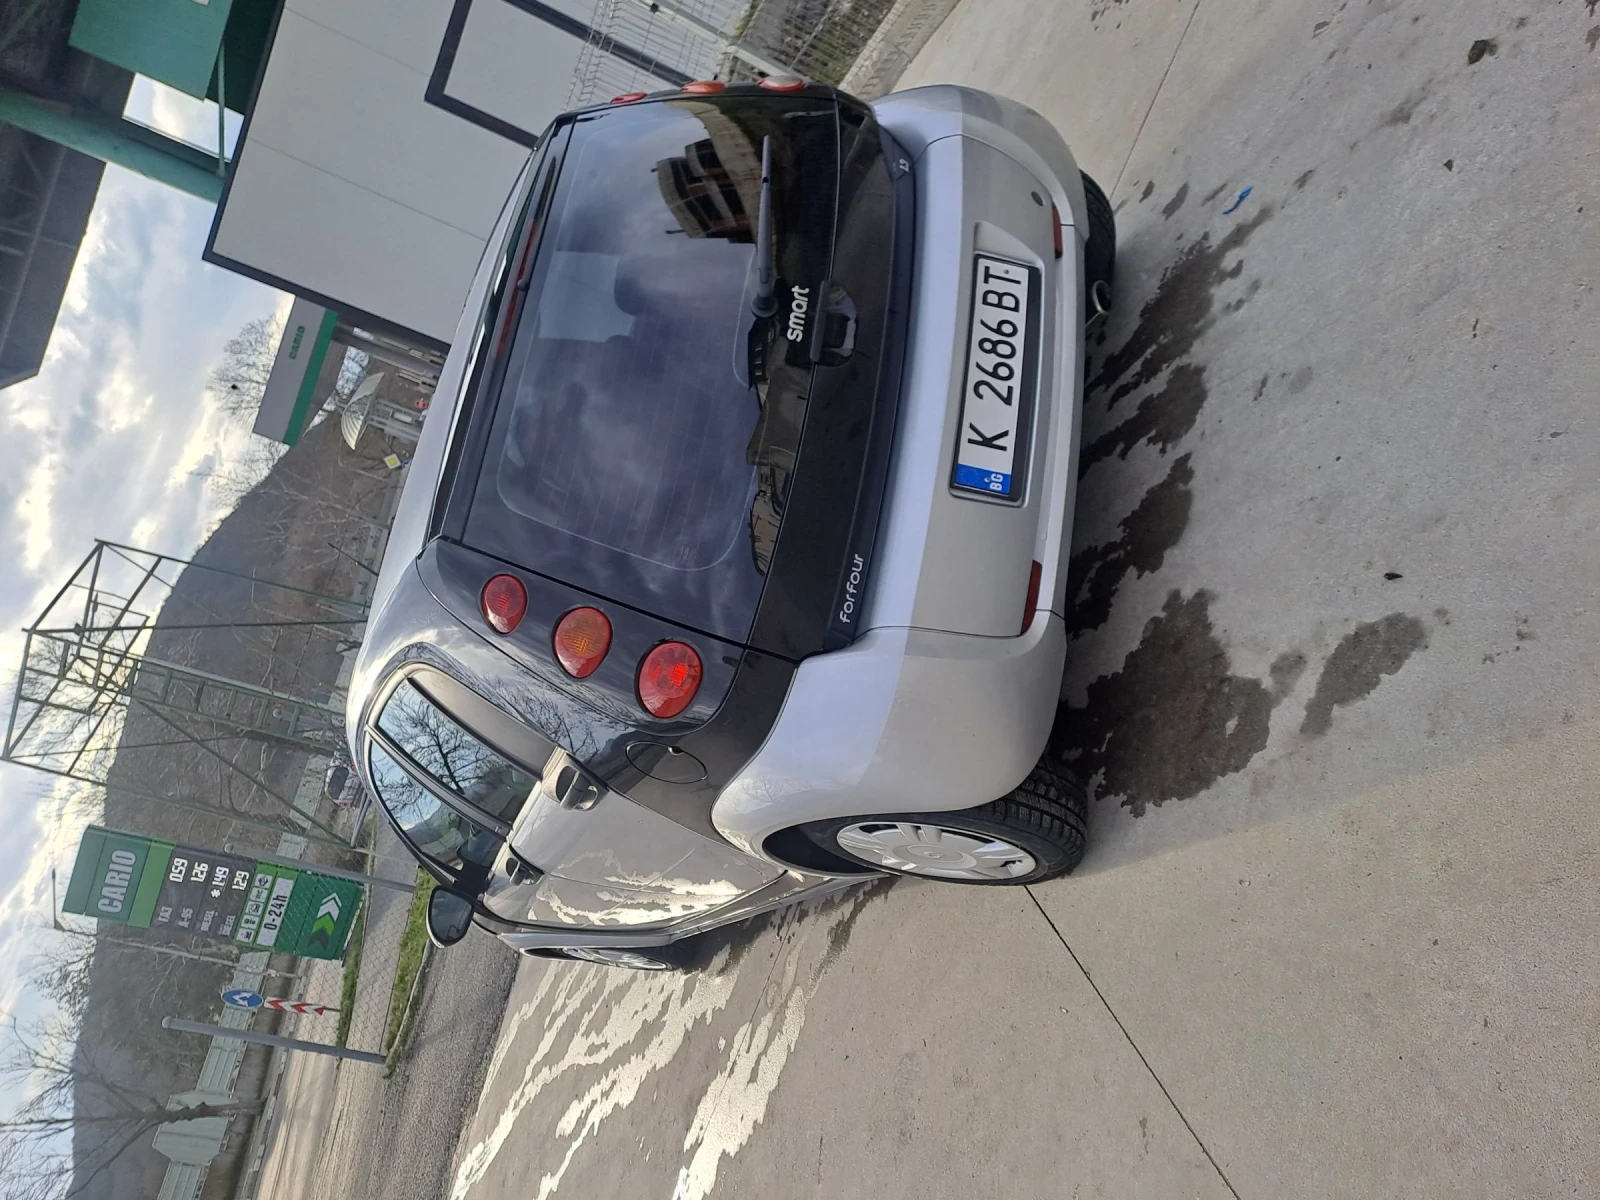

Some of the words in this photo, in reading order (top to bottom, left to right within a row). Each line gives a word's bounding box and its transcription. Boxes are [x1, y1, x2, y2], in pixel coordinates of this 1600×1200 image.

[786, 285, 810, 342] smart
[967, 422, 1010, 452] K
[989, 473, 1004, 491] BG
[840, 553, 864, 623] forfour
[97, 849, 136, 913] CARIO
